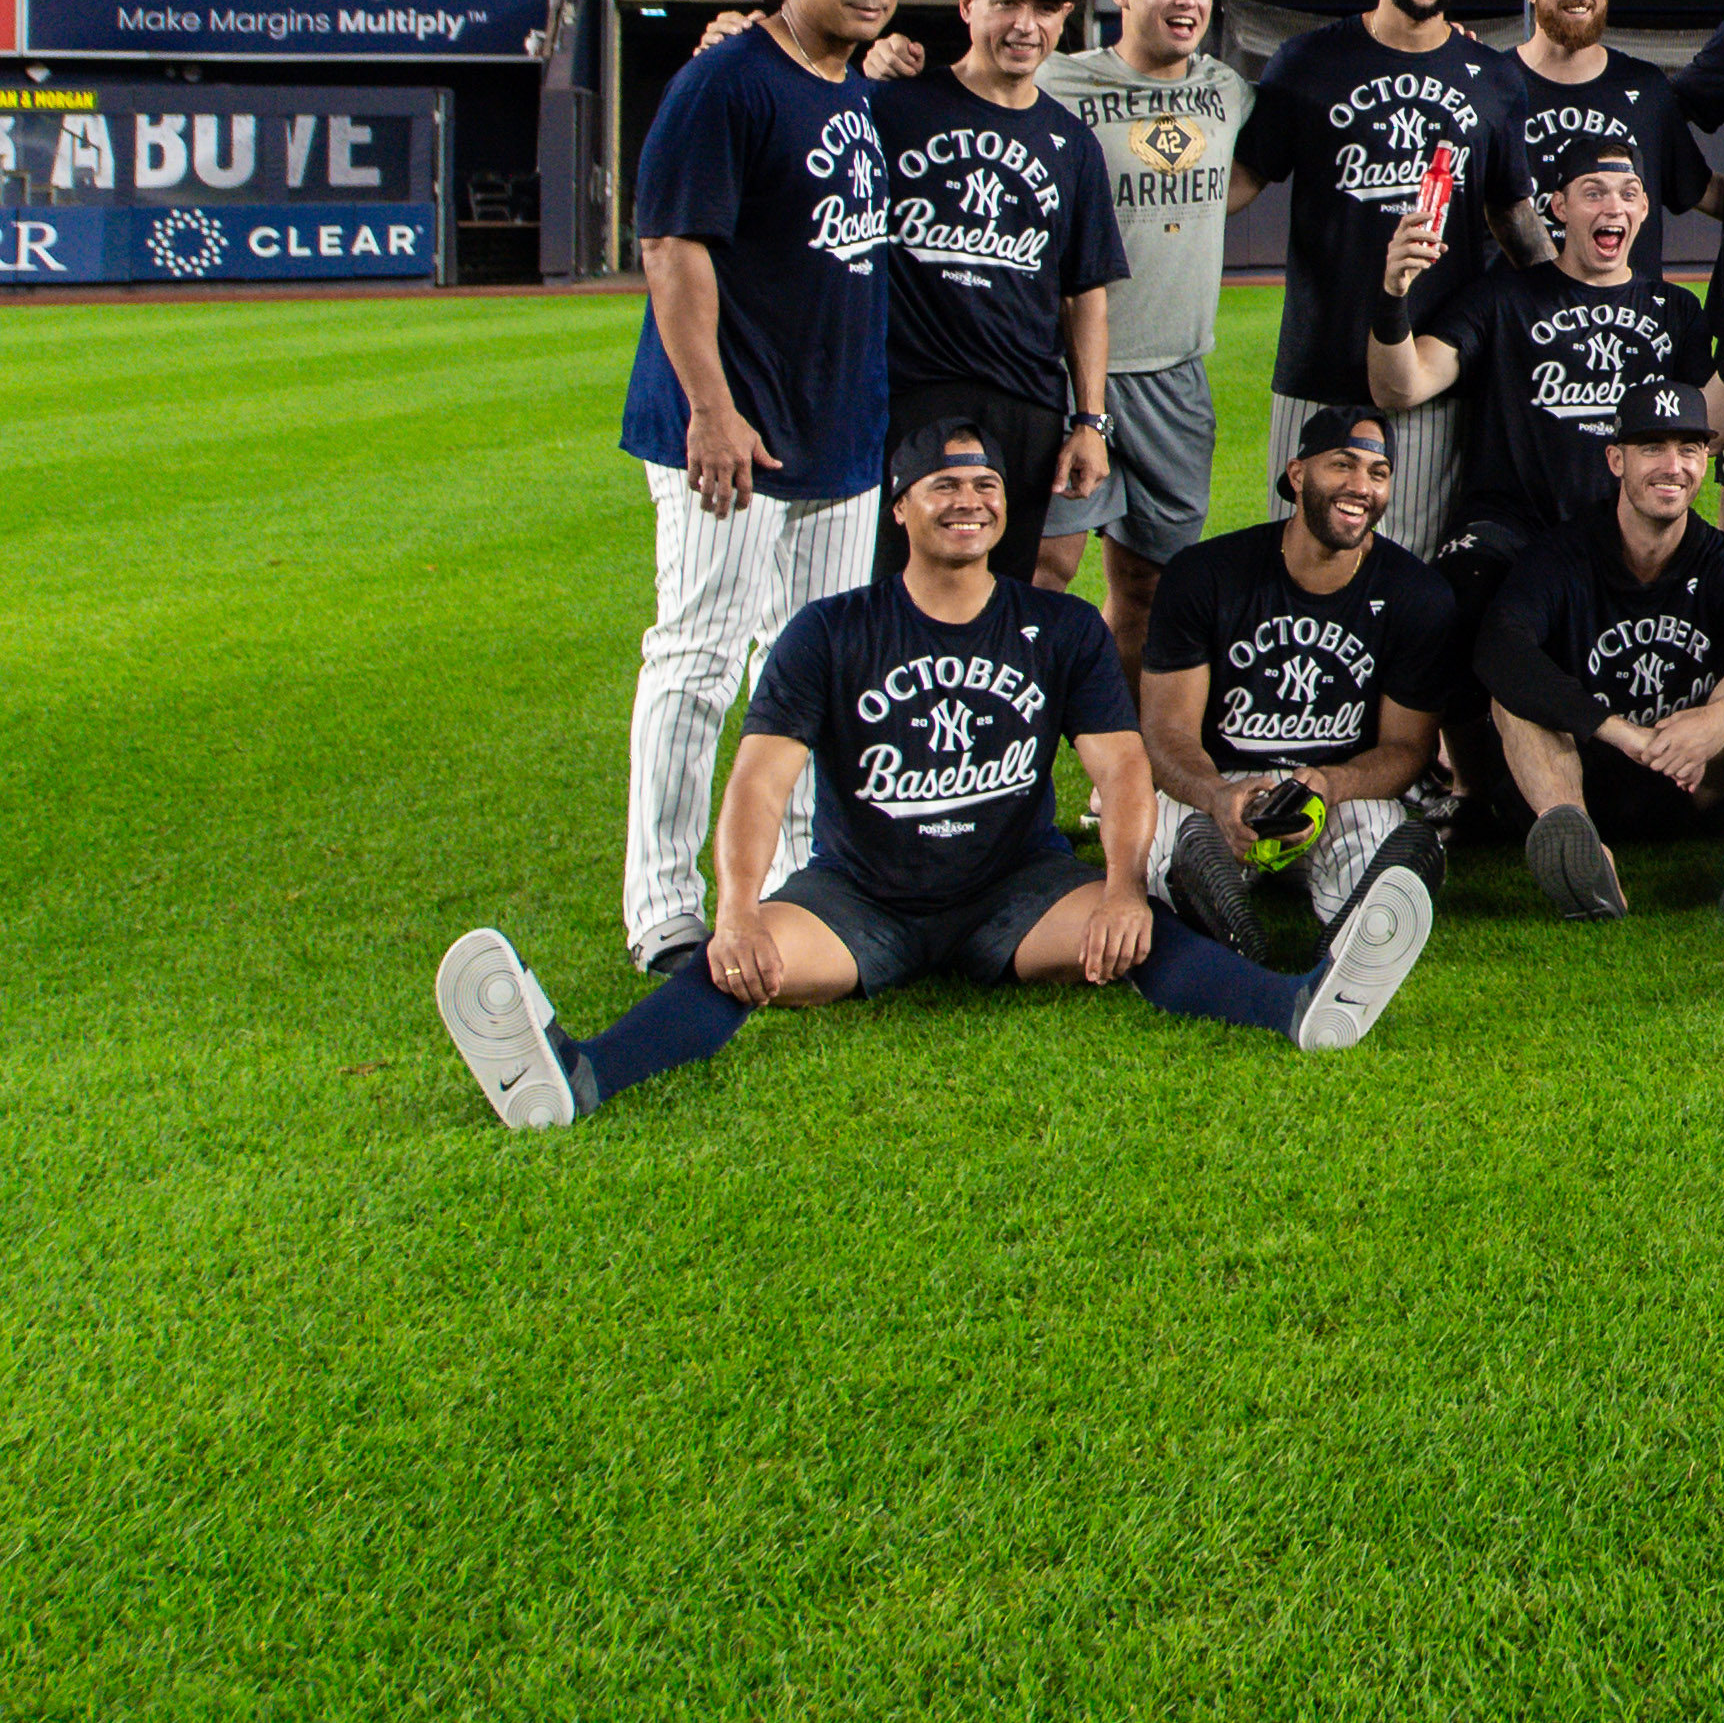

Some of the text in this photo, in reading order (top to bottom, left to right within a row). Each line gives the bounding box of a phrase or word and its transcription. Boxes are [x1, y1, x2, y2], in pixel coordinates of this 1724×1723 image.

[118, 7, 201, 33] Make
[209, 8, 331, 41] Margins
[35, 91, 94, 108] MORGAN
[1078, 82, 1226, 129] BREAKING
[1329, 74, 1477, 133] OCTOBER
[1155, 132, 1182, 154] 42
[1336, 144, 1470, 191] Basebll
[899, 129, 1062, 216] OCTOBER
[1117, 165, 1224, 206] ARRIERS
[249, 225, 416, 257] CLEAR
[889, 197, 1049, 270] Baseball
[1531, 305, 1671, 361] OCTOBER
[1228, 615, 1375, 689] OCTOBER
[1588, 614, 1711, 675] OCTOBER
[857, 655, 1045, 724] OCTOBER
[1220, 687, 1366, 748] Baseball
[855, 735, 1038, 811] Baseball
